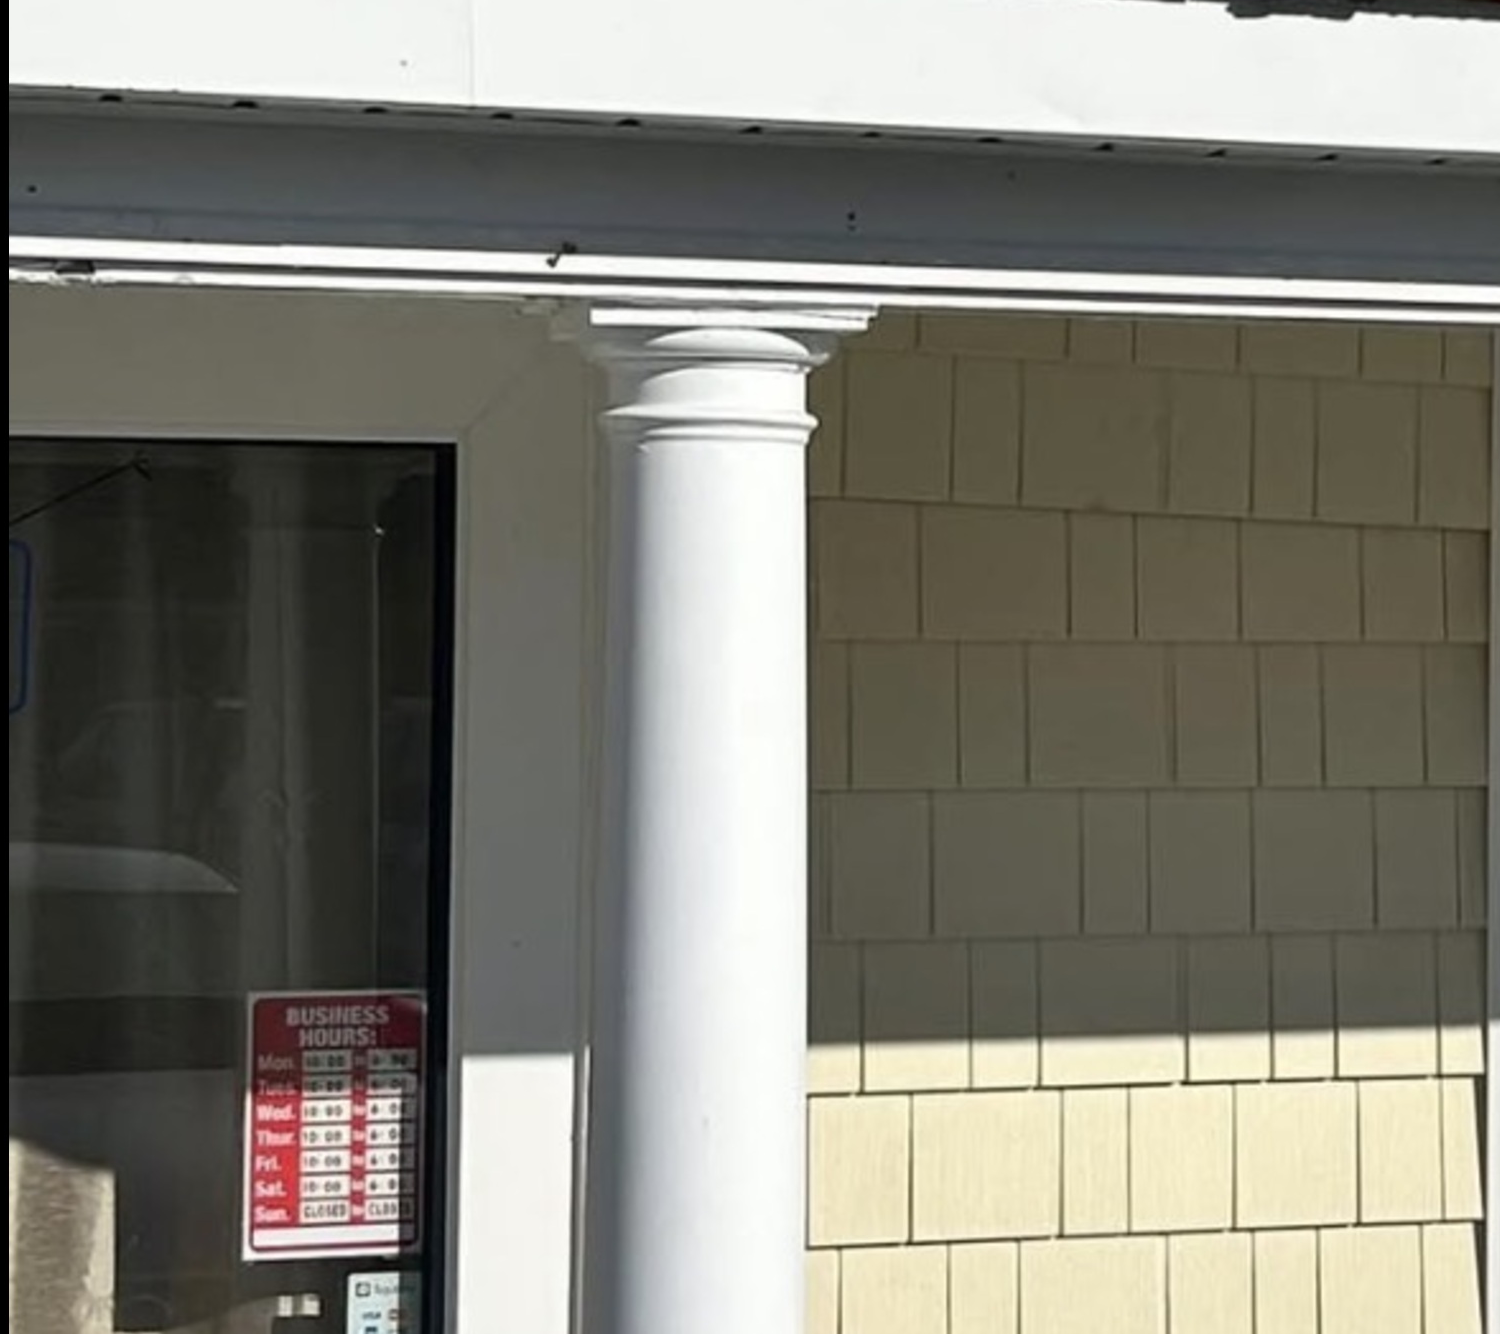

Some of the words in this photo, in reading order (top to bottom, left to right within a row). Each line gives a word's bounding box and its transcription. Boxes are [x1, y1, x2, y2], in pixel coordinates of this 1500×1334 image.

[285, 1005, 391, 1027] BUSINESS
[299, 1027, 378, 1048] HOURS:
[257, 1103, 297, 1122] Wed.
